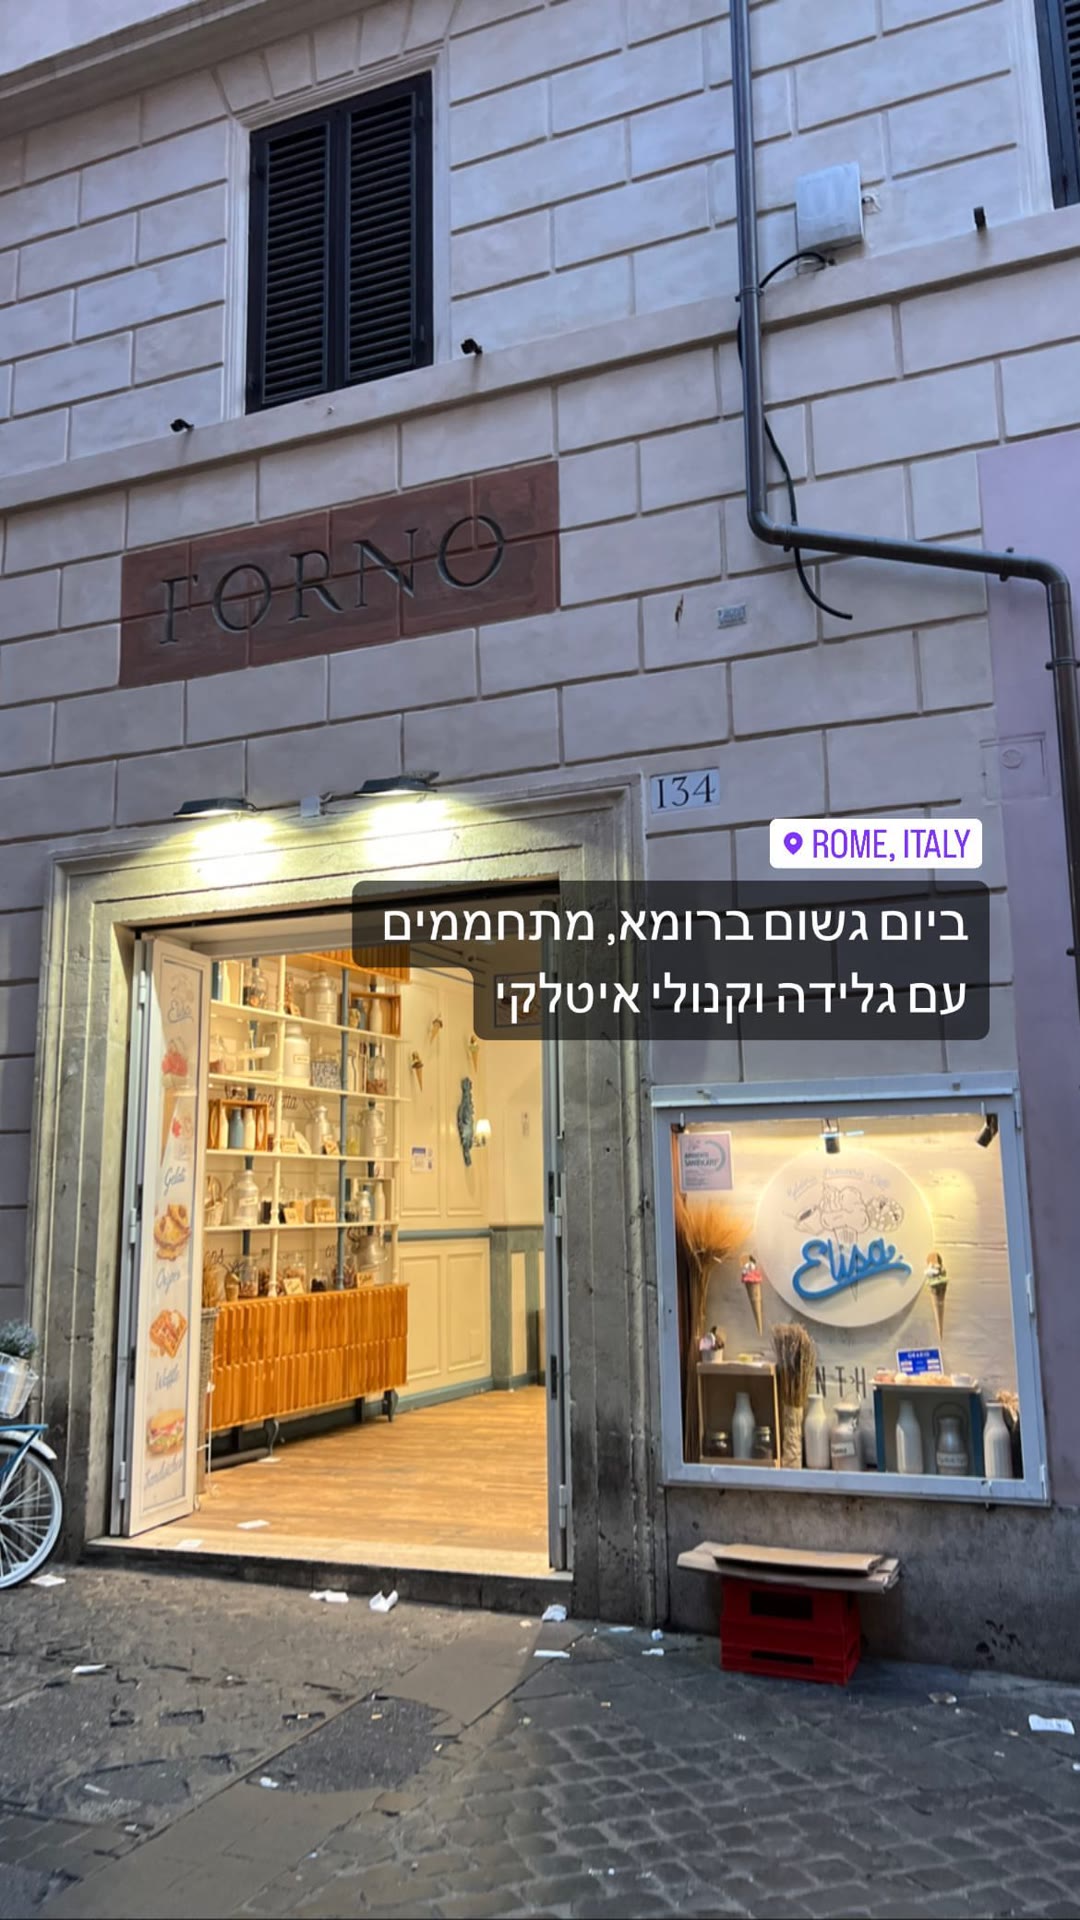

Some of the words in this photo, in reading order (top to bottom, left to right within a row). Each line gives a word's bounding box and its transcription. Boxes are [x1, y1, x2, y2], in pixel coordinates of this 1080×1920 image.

[158, 514, 506, 646] FORNO
[656, 772, 716, 810] 134
[792, 1237, 912, 1301] Elisa
